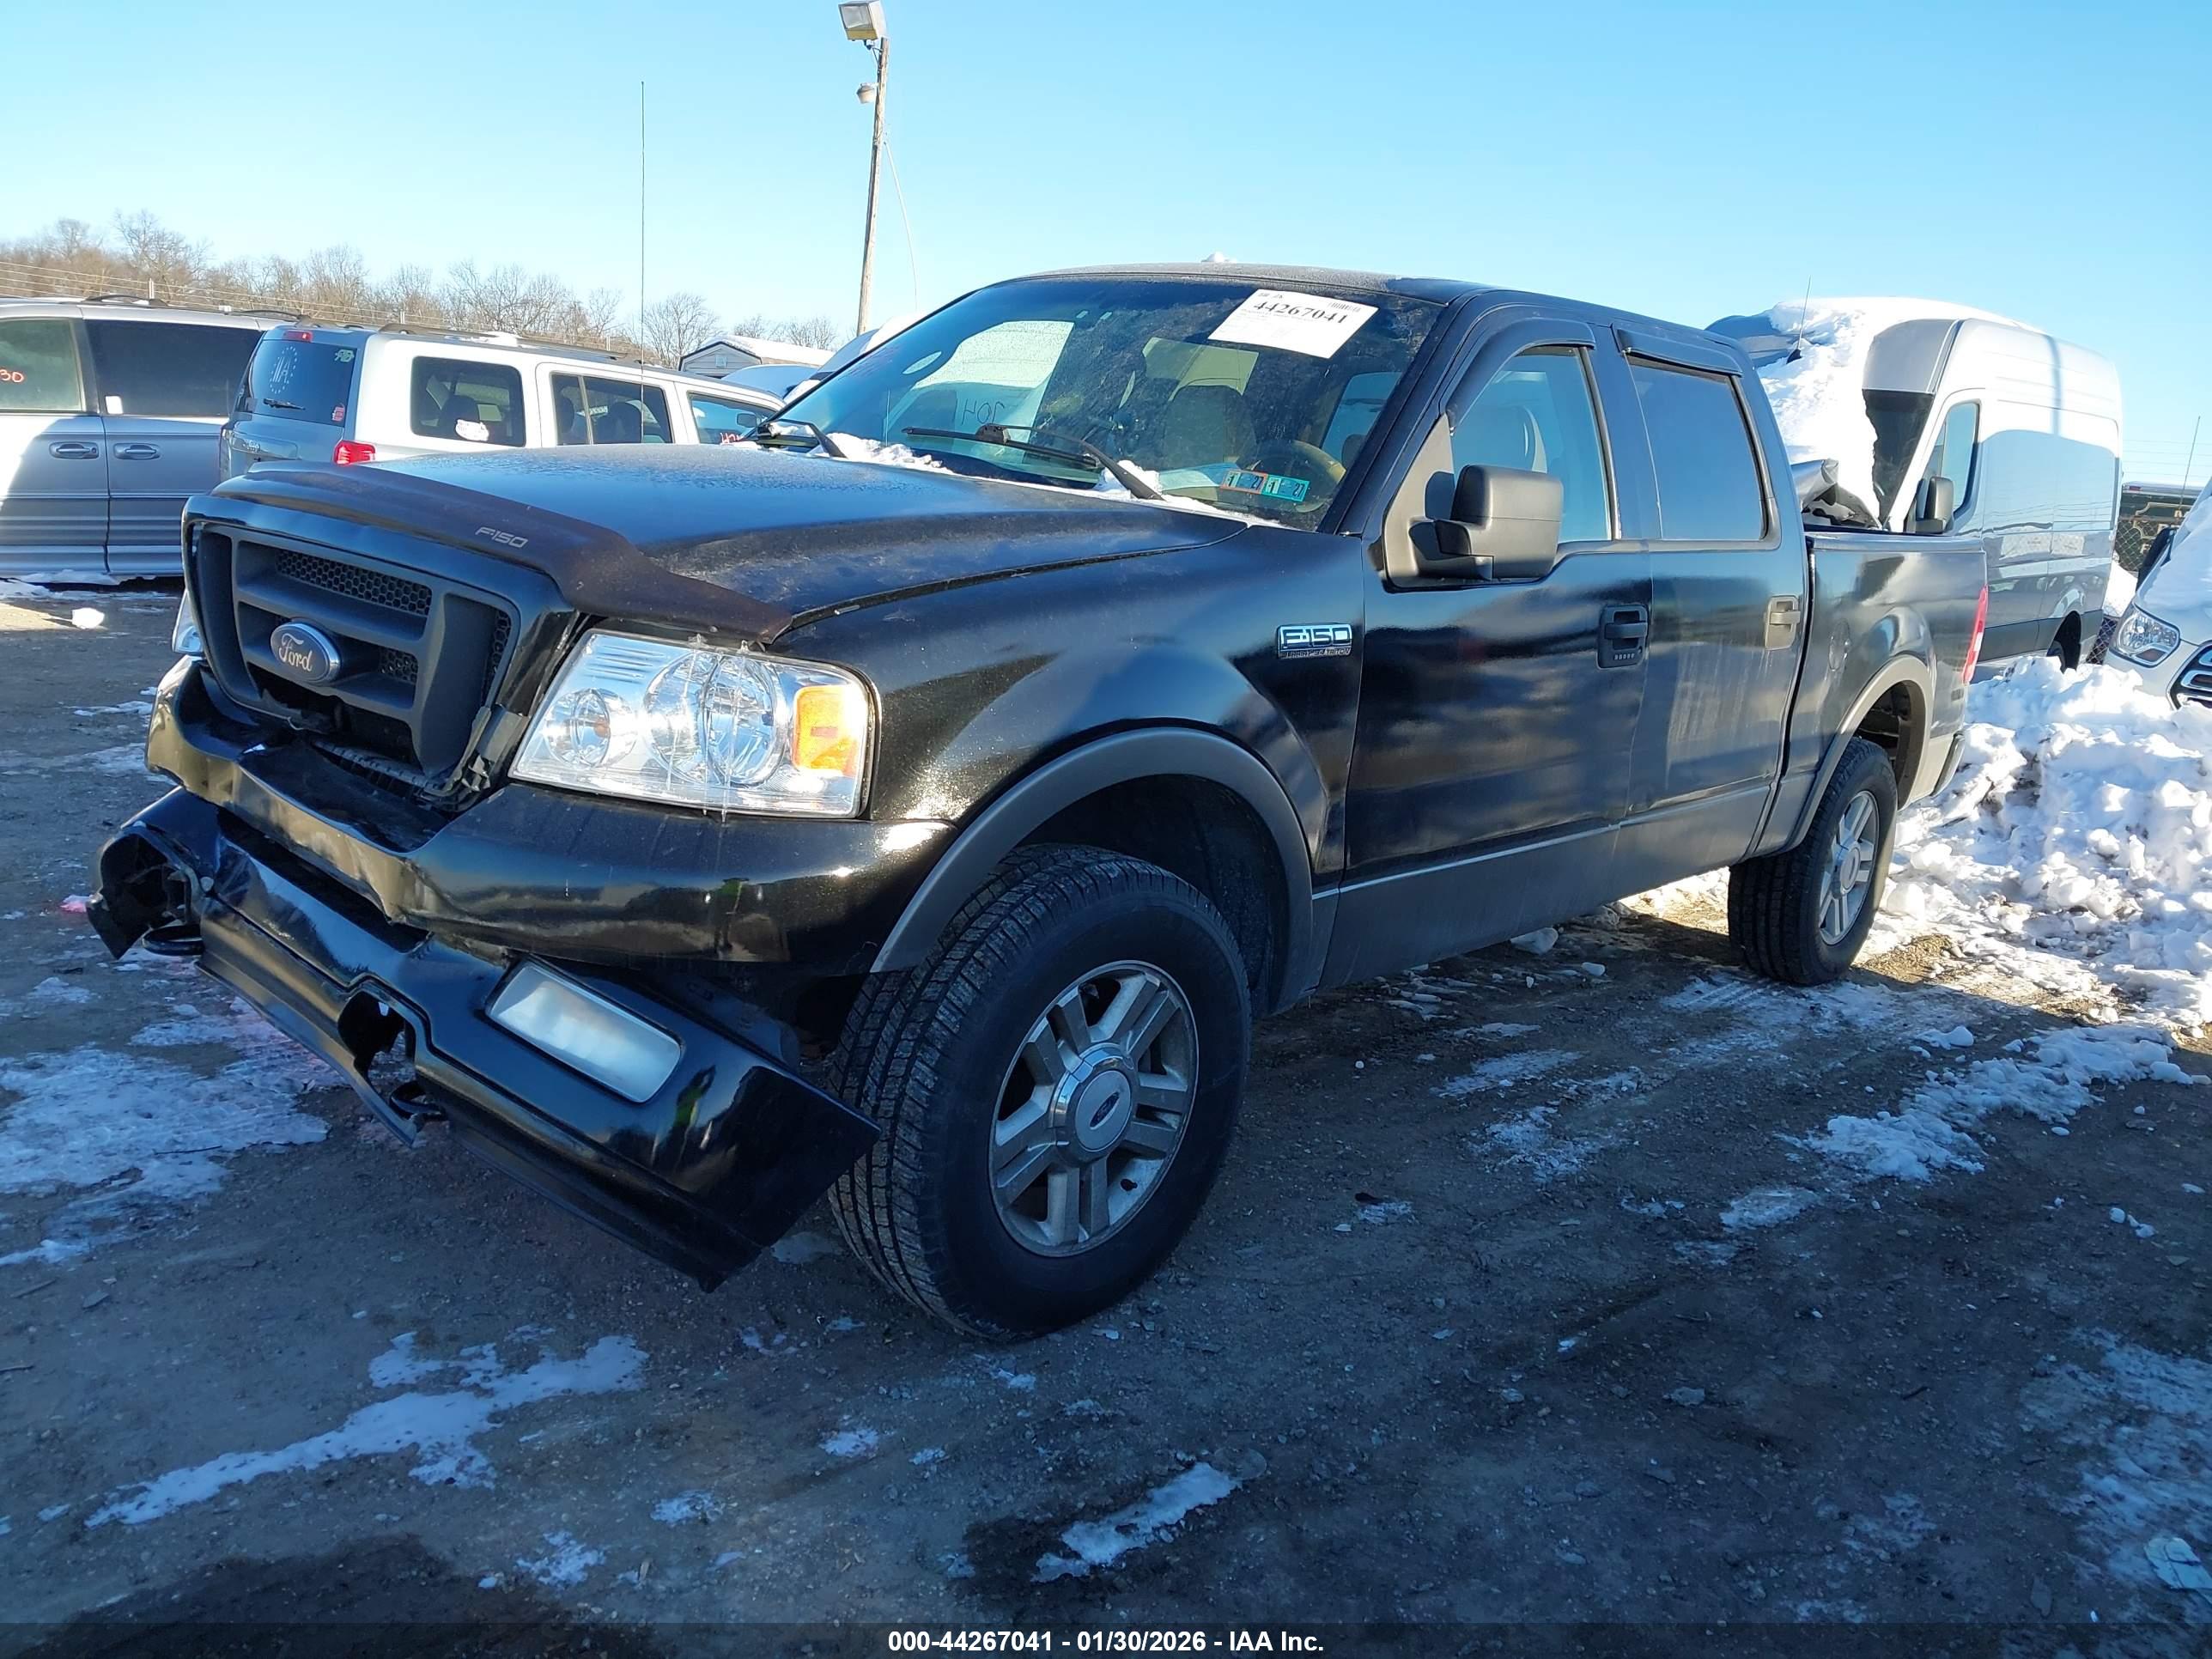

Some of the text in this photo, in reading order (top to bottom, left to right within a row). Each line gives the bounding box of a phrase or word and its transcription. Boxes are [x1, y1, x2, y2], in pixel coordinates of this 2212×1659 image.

[1254, 301, 1348, 324] 44267041
[1250, 476, 1264, 489] 27
[1292, 483, 1305, 497] 27
[278, 632, 313, 672] Ford
